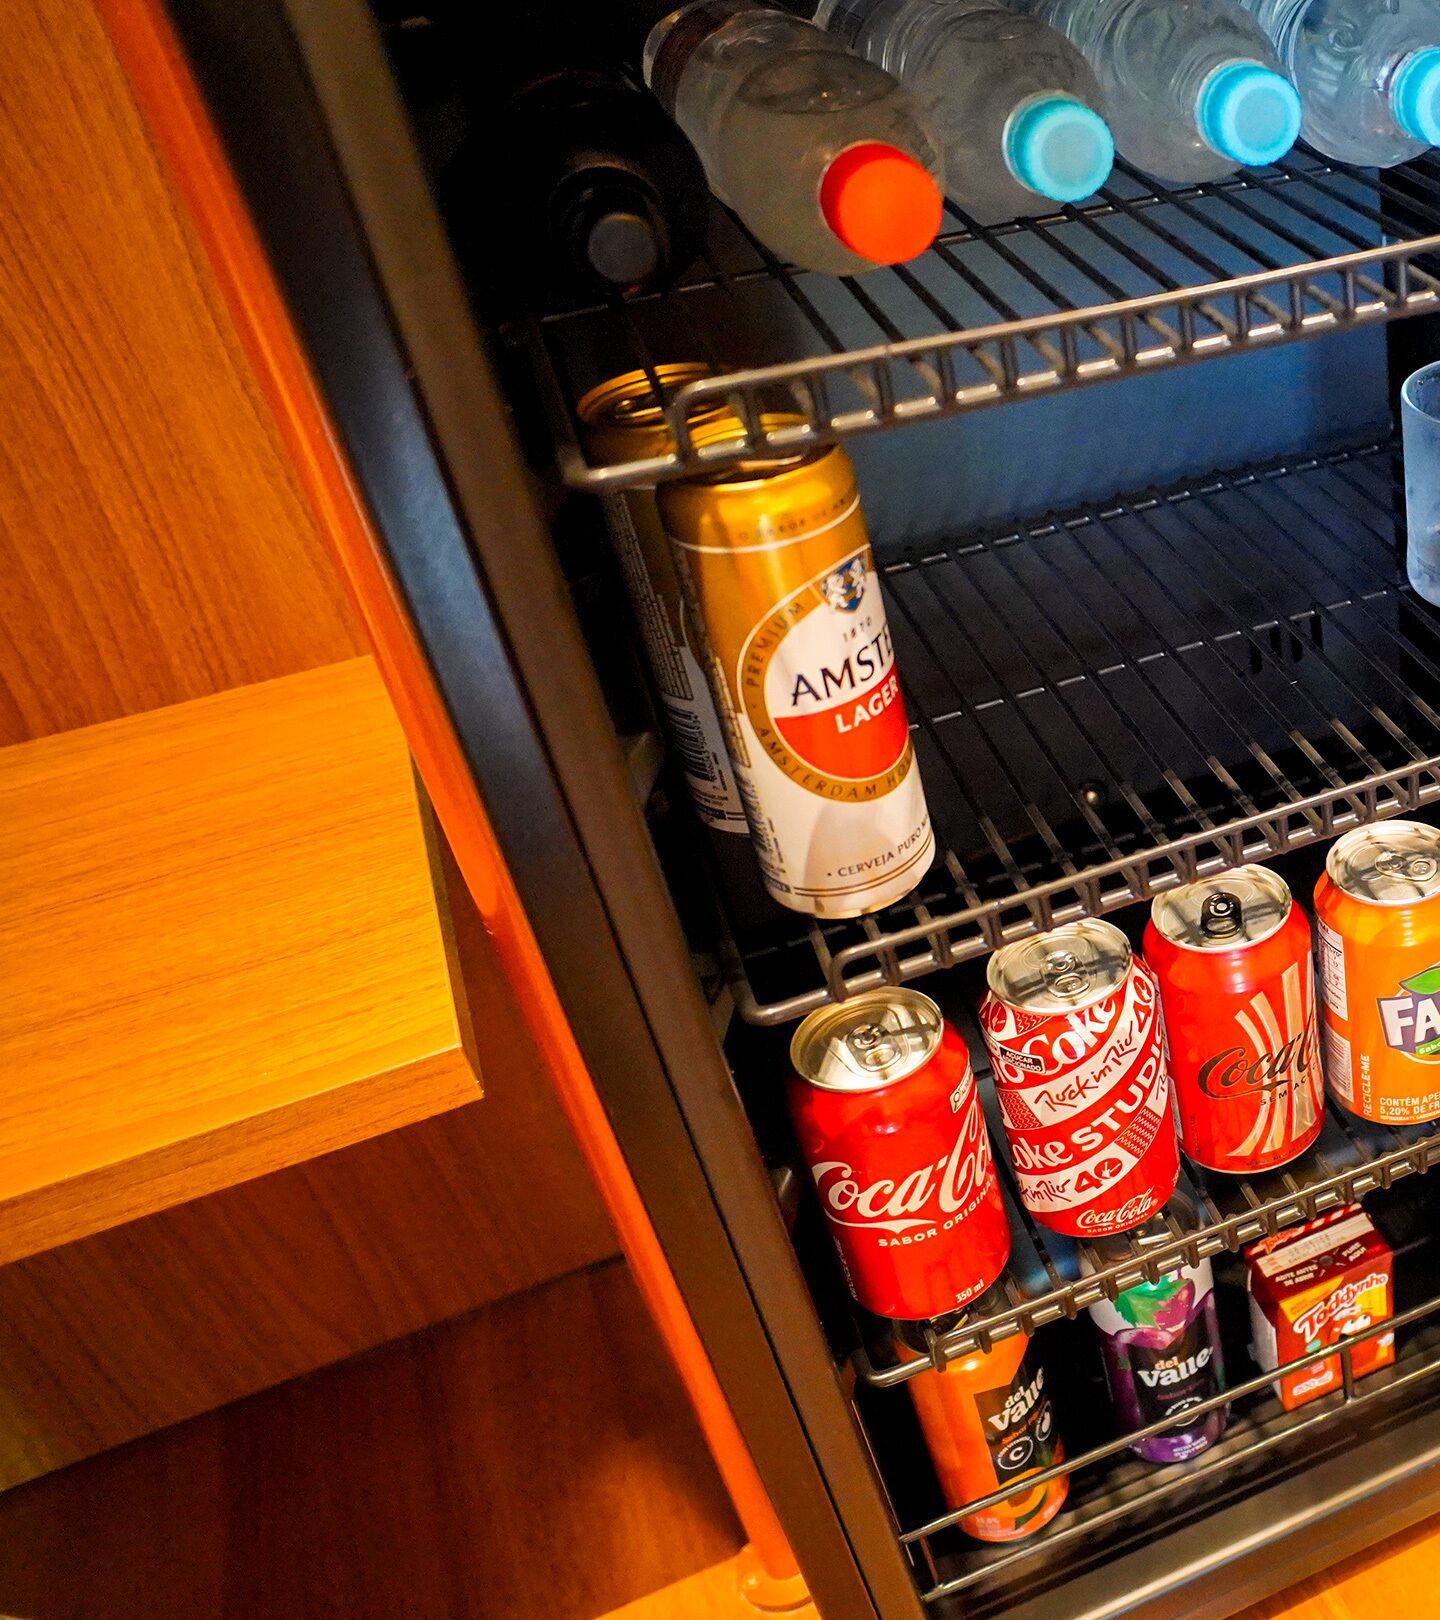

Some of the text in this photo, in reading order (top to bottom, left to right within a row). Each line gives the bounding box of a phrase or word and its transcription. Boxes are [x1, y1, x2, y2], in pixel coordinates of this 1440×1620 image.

[745, 602, 804, 688] PREMIUM
[834, 675, 900, 735] LAGER
[758, 726, 878, 799] AMSTERDAM
[837, 827, 922, 878] CERVEJA PURO
[1033, 1075, 1099, 1112] Rock
[1360, 1053, 1373, 1117] RECICLE-ME
[1413, 1104, 1427, 1115] DE
[1012, 1136, 1074, 1170] oke
[1075, 1186, 1156, 1229] Coca-Cola
[877, 1227, 938, 1248] SABOR
[955, 1278, 985, 1304] 350 ml
[1292, 1272, 1389, 1344] Toddynho
[1154, 1356, 1179, 1371] del
[1004, 1386, 1026, 1408] del
